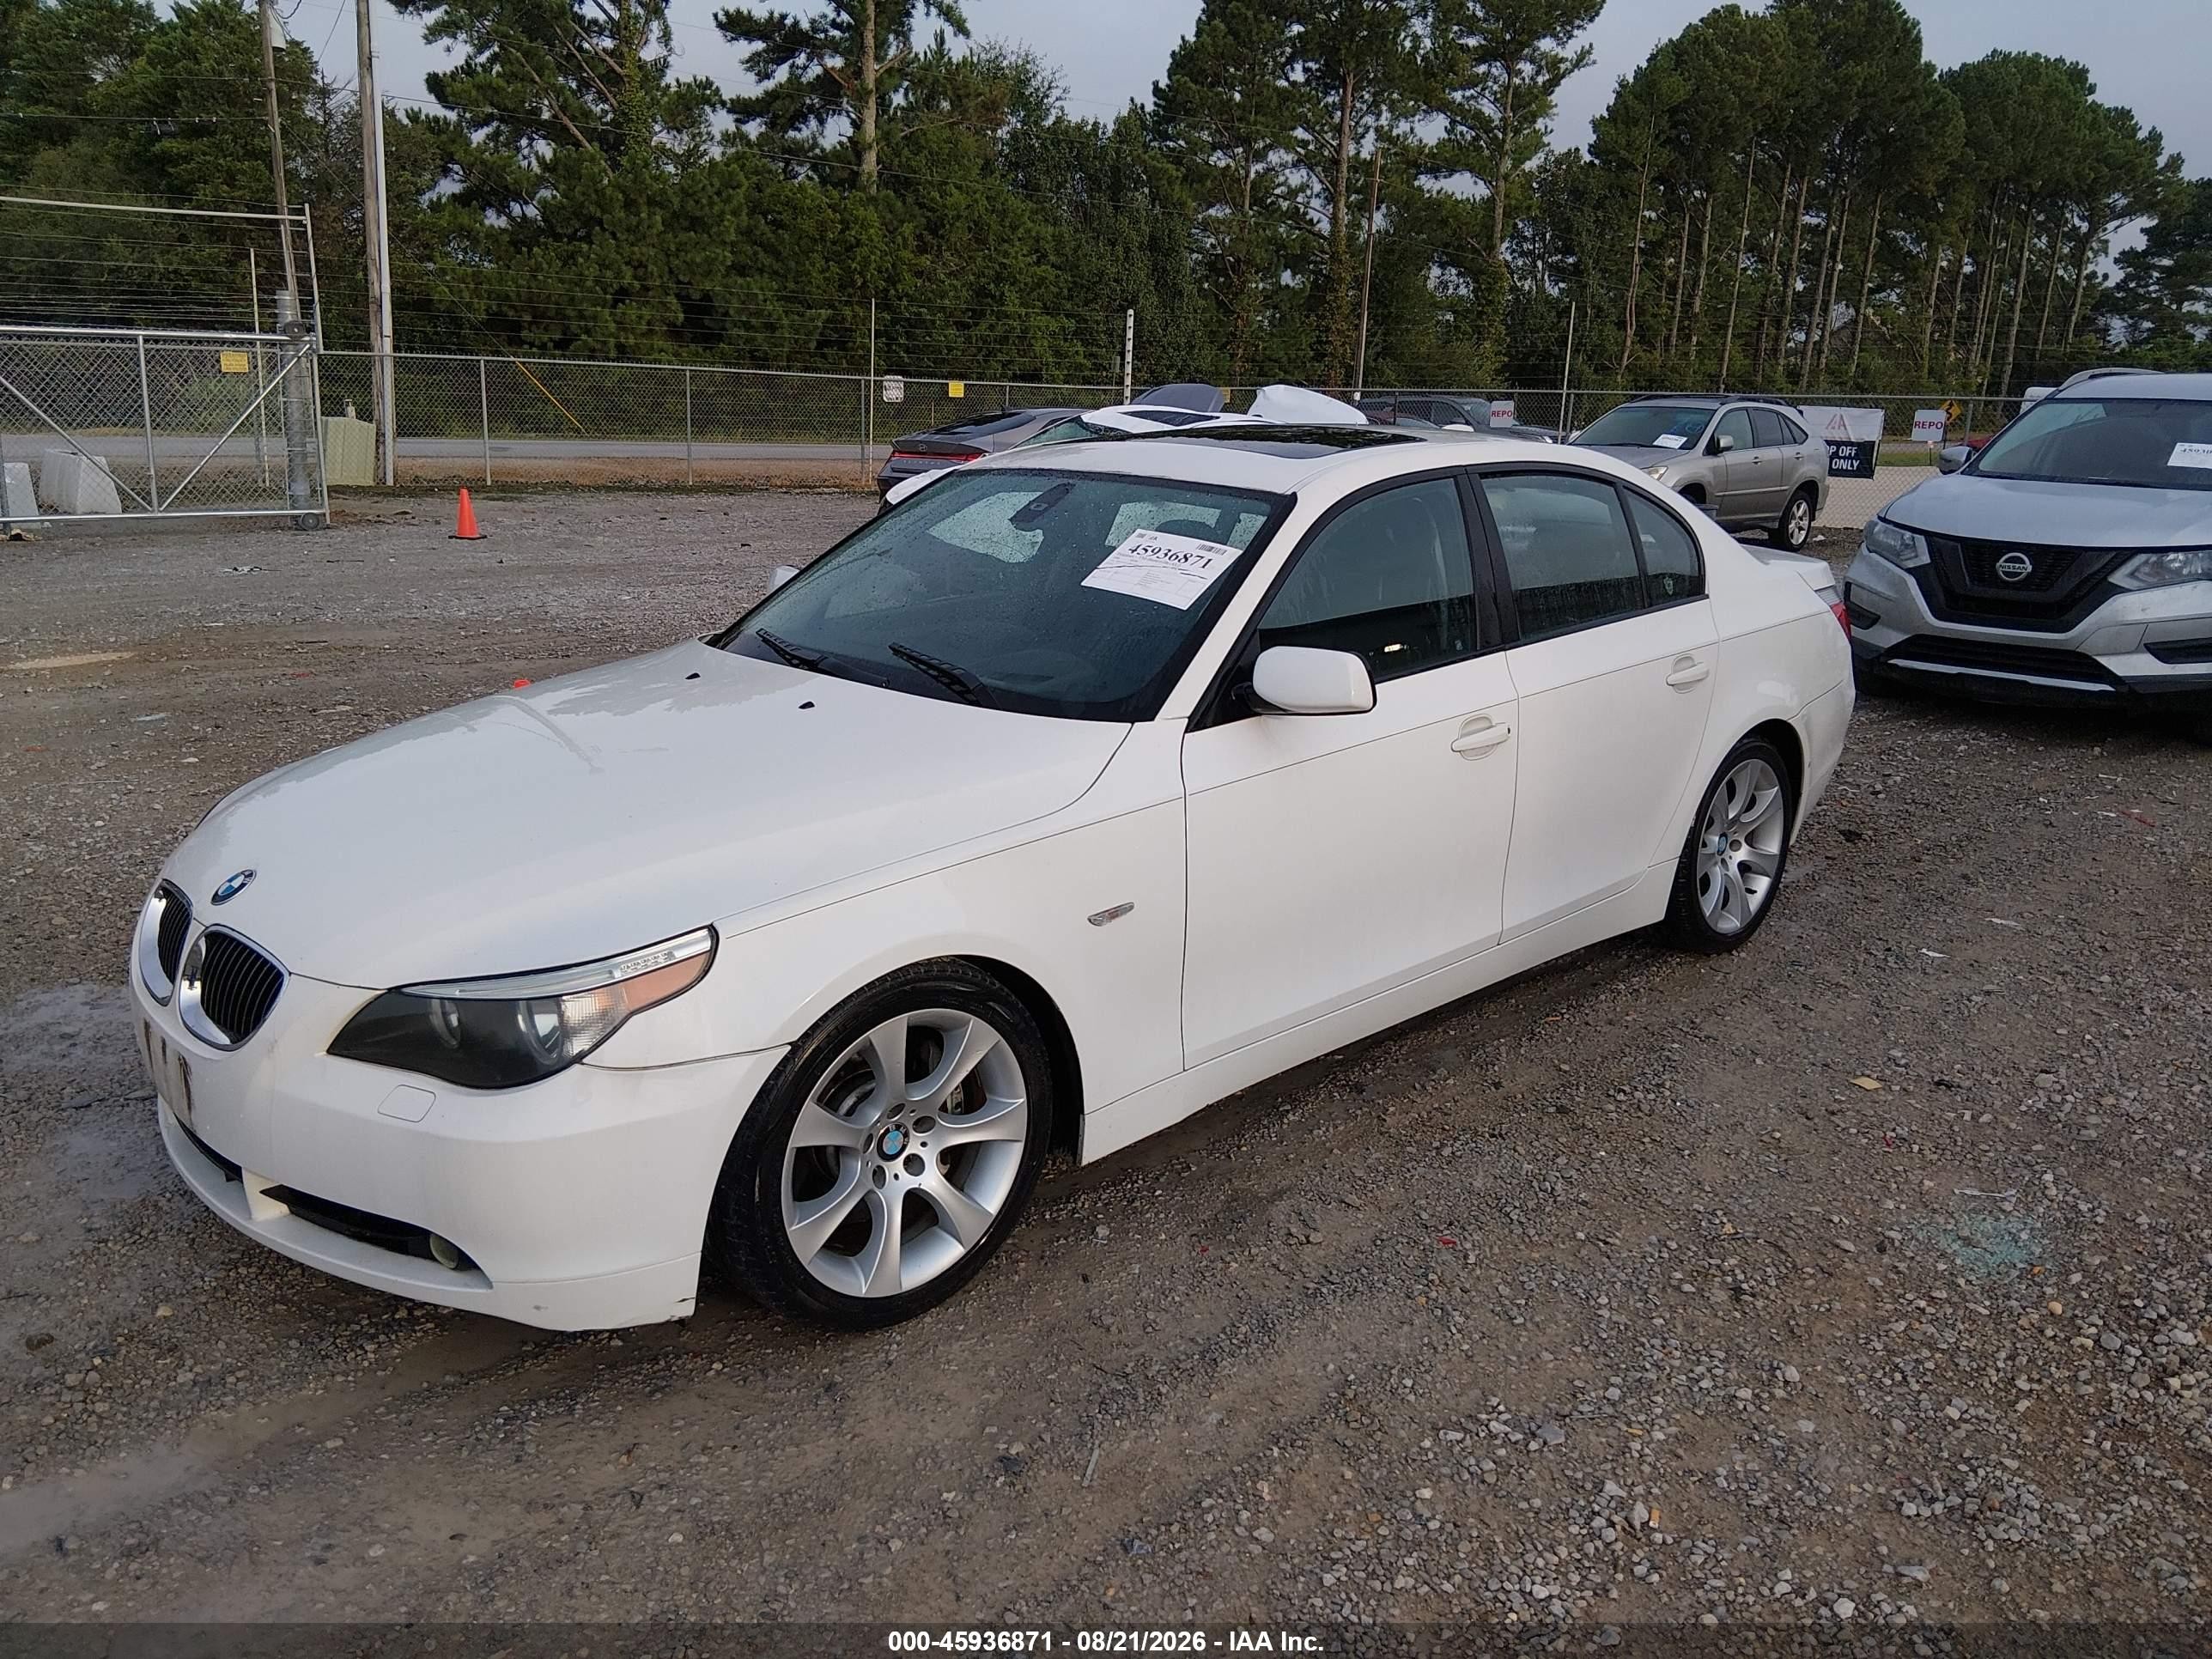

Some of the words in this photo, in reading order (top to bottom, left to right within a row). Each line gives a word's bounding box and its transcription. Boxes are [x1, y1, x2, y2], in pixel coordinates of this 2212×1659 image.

[1491, 410, 1513, 418] REPO
[1913, 421, 1944, 430] REPO
[1838, 446, 1858, 457] OFF
[1832, 459, 1860, 471] ONLY
[1128, 543, 1213, 568] 45936871
